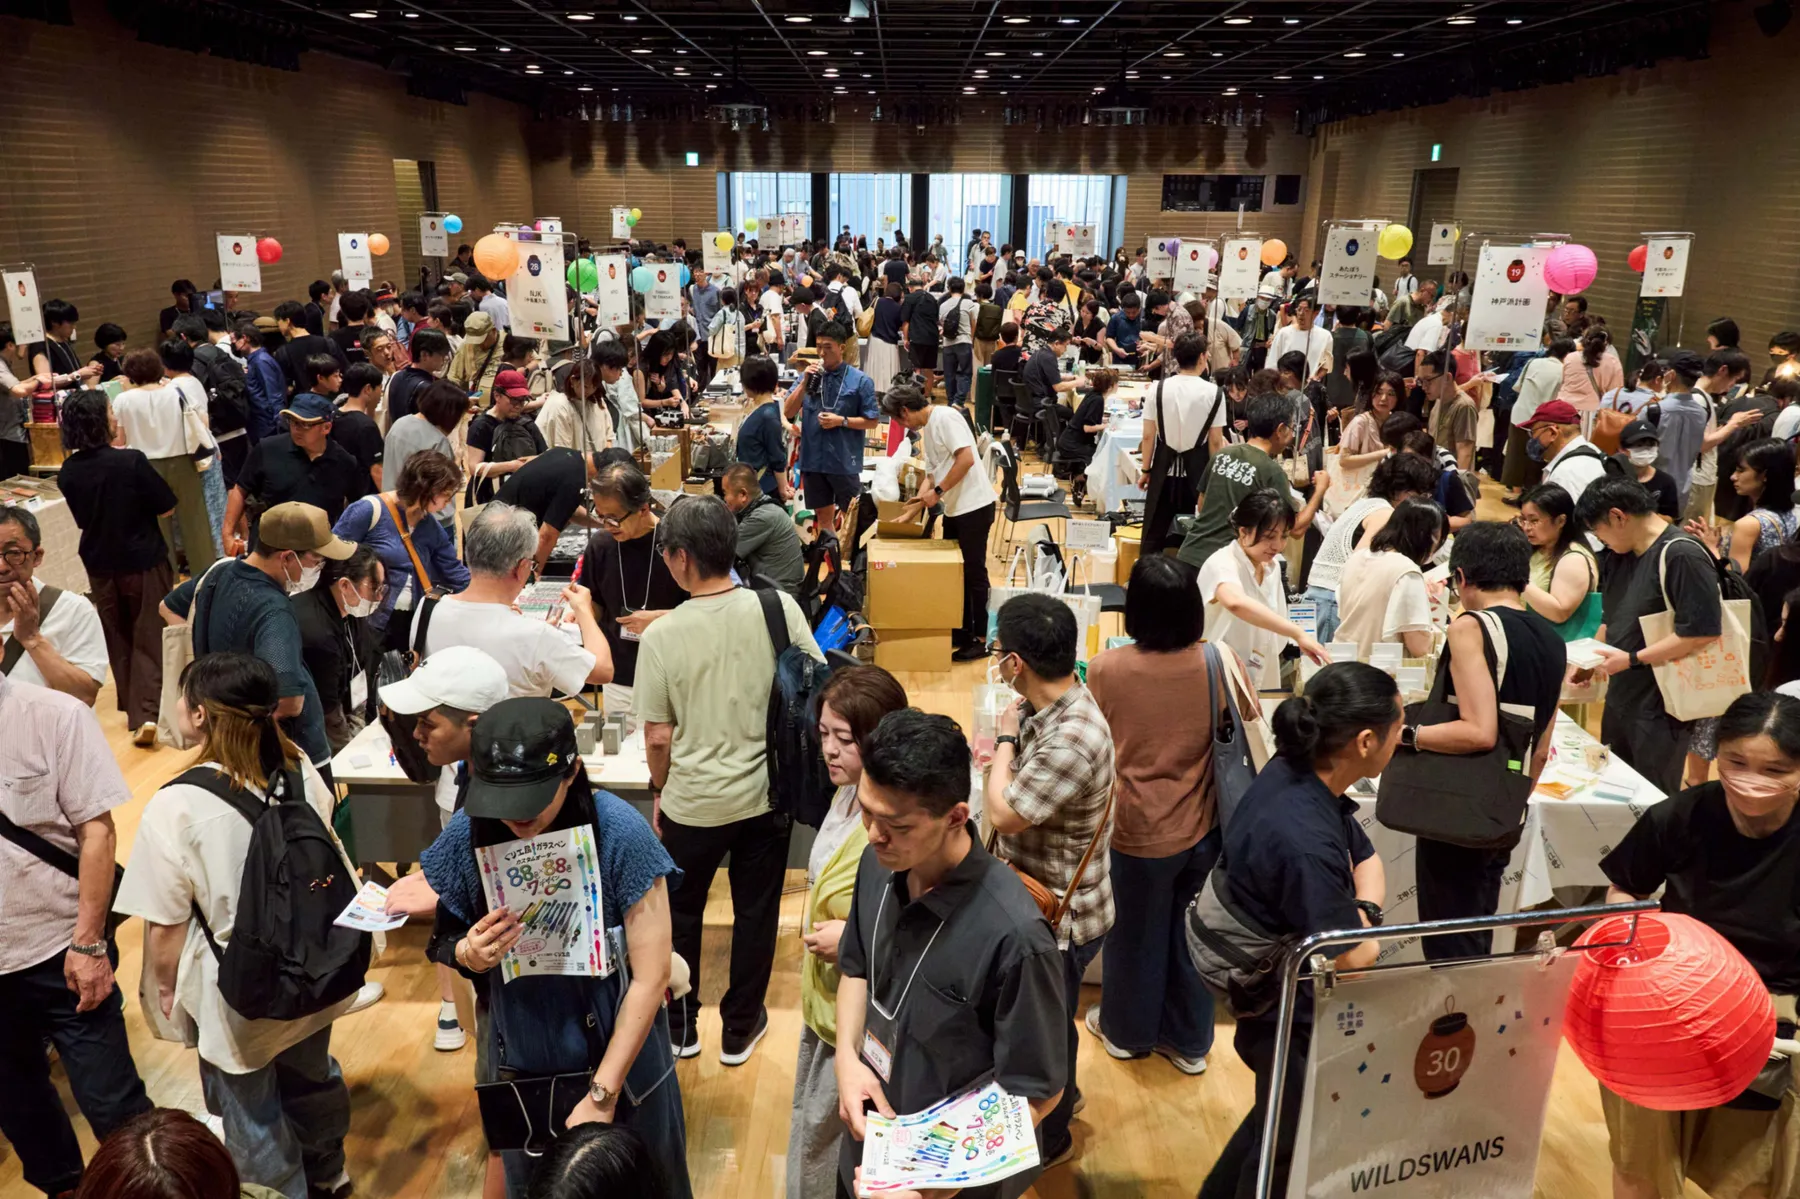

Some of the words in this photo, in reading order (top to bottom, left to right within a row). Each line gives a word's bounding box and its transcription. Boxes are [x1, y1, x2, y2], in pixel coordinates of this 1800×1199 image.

[530, 262, 539, 271] 28
[1511, 269, 1521, 277] 19
[529, 289, 542, 297] NJK
[1491, 297, 1531, 306] 神戸派計画
[536, 840, 567, 851] ガラスペン
[515, 851, 558, 866] カスタムオーダー
[1426, 1047, 1461, 1076] 30
[1001, 1097, 1012, 1136] カスタムオーダー
[1012, 1111, 1024, 1141] ガラスペン
[1350, 1136, 1505, 1193] WILDSWANS
